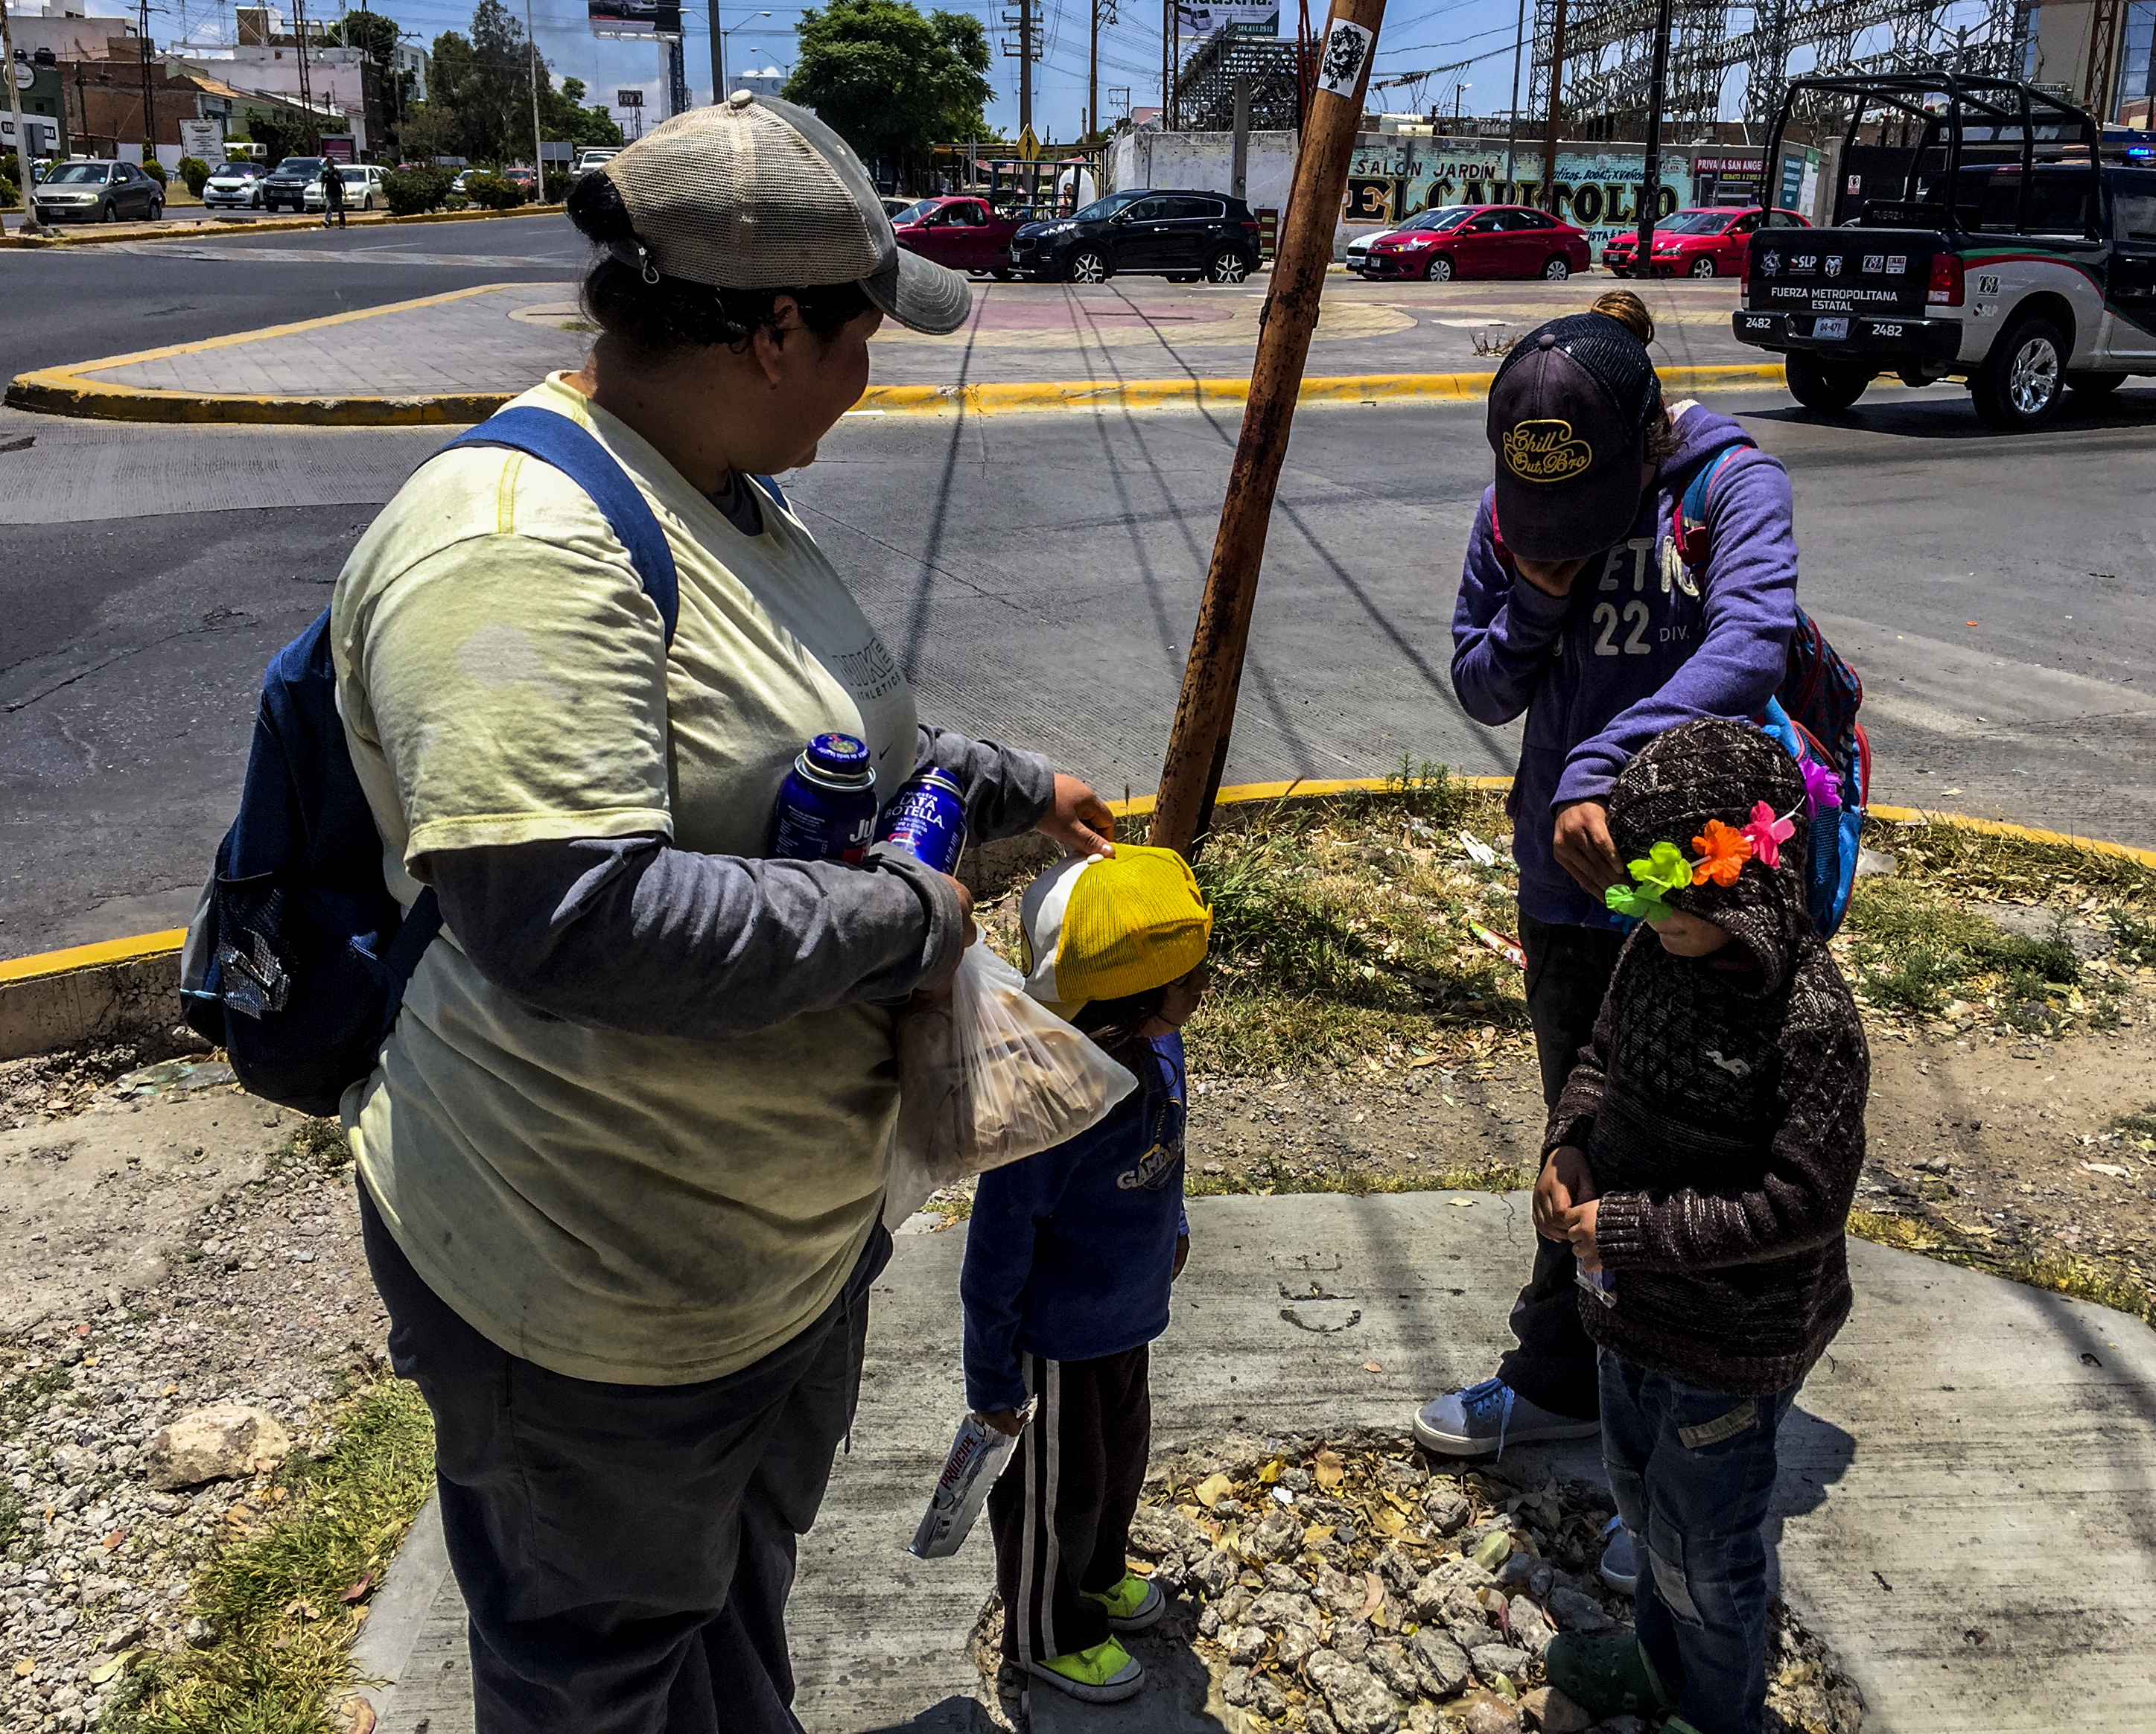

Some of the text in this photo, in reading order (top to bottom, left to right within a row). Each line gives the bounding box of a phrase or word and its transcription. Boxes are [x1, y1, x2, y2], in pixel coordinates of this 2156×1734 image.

[1698, 159, 1726, 170] PRIVAA
[1798, 255, 1817, 268] SLP
[1771, 287, 1898, 302] FUERZA METROPOLITANA
[1812, 300, 1854, 311] ESTATAL
[1746, 317, 1771, 329] 2482
[1872, 324, 1903, 337] 2482
[1513, 430, 1557, 453] Chill
[1543, 450, 1587, 474] Bro
[1592, 599, 1652, 657] 22
[1659, 625, 1690, 643] DIV.
[831, 637, 894, 687] NIKE
[899, 796, 936, 812] LATA
[940, 1433, 978, 1491] PRINCIPE
